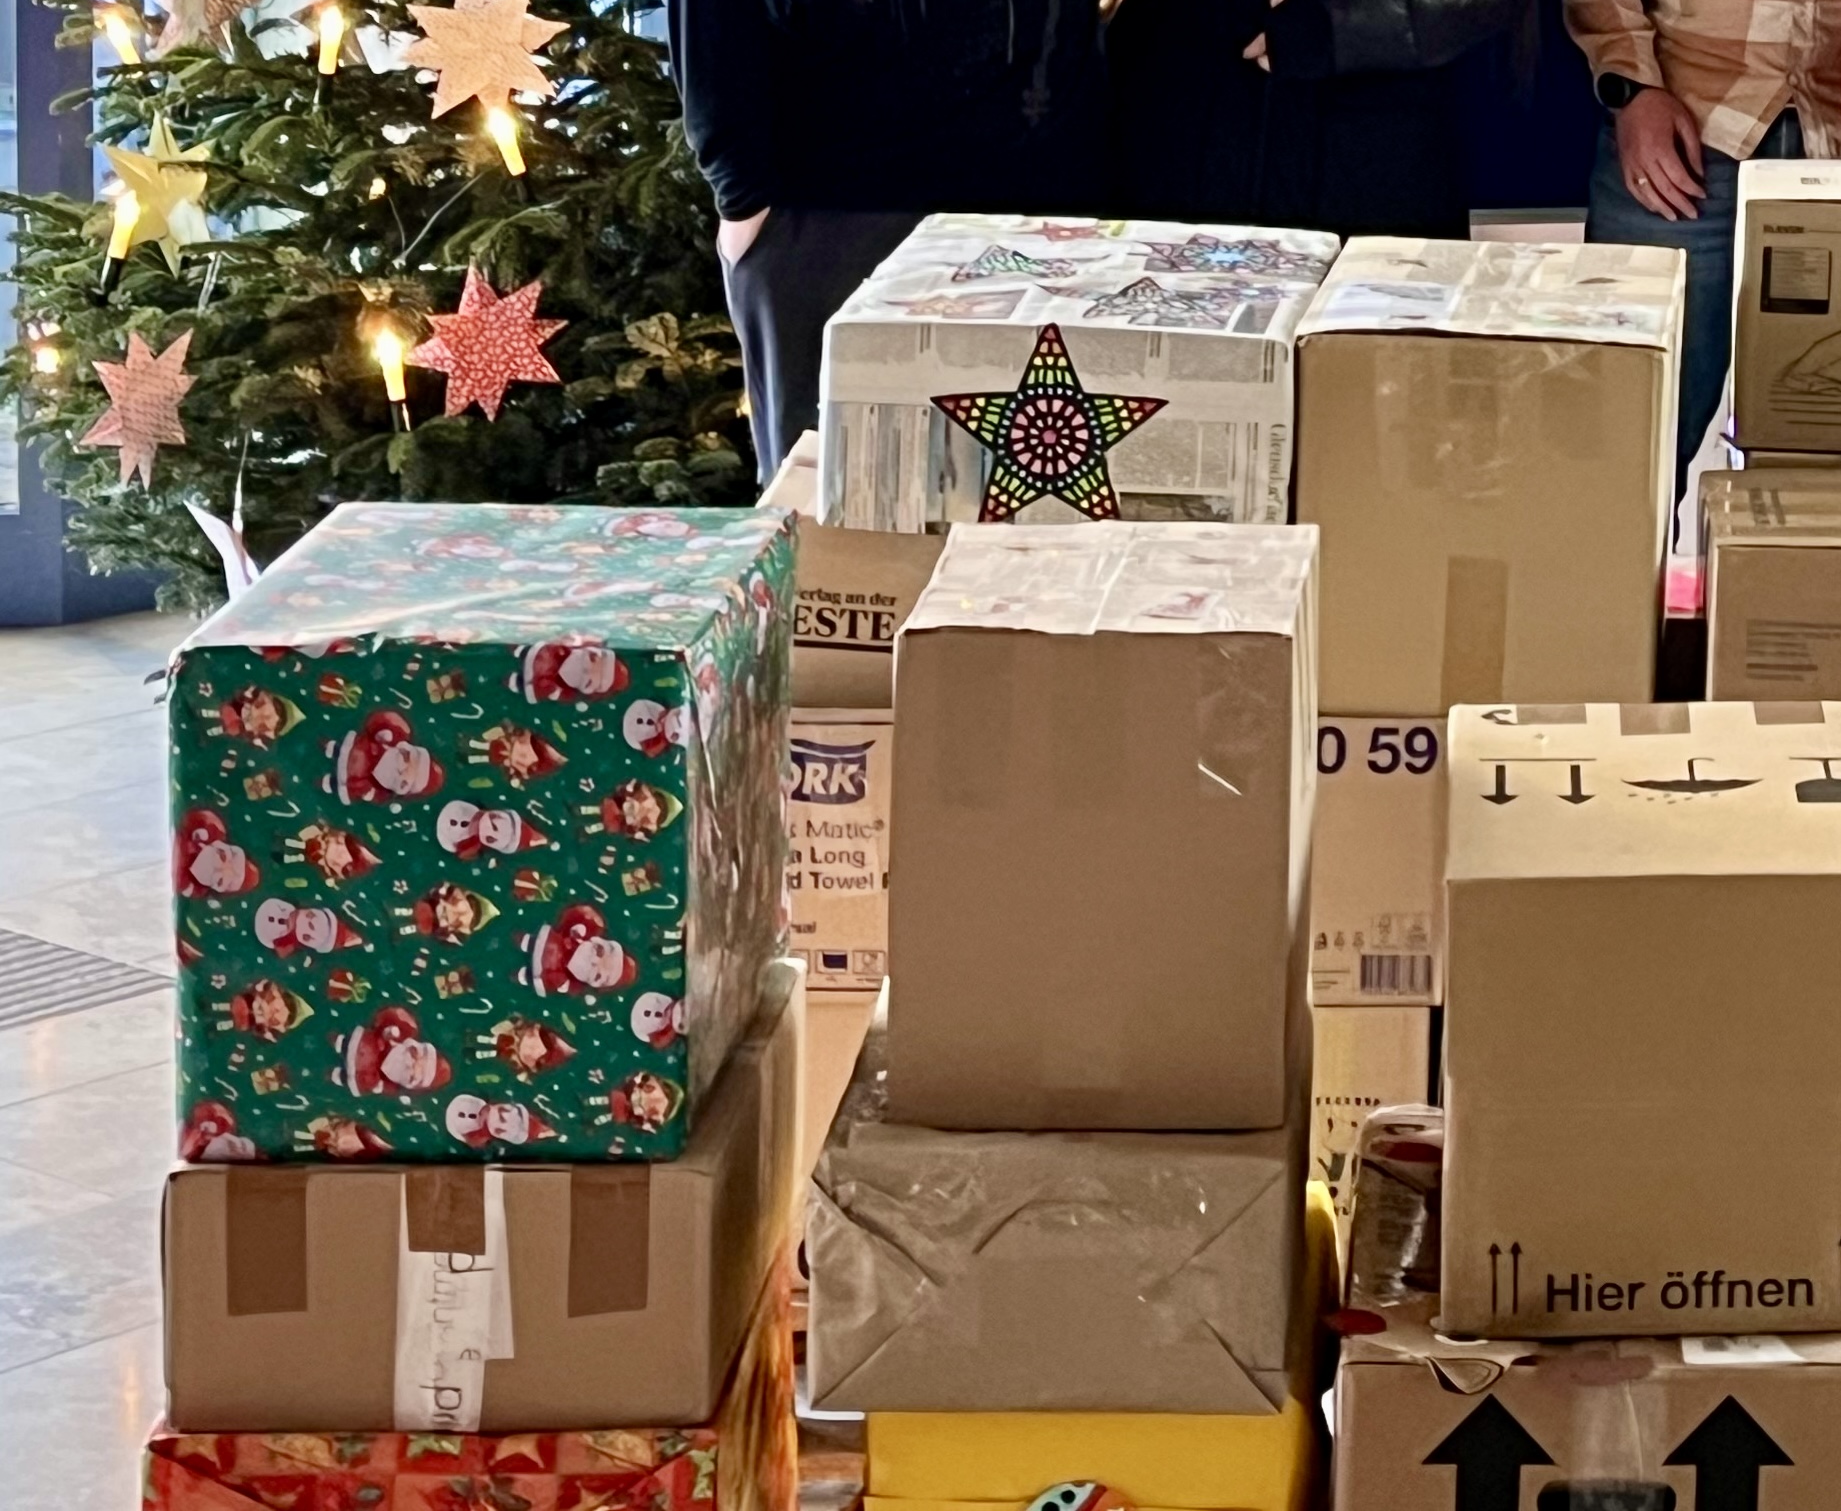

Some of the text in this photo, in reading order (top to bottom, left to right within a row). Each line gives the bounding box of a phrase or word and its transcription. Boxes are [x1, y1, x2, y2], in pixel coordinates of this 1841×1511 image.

[1367, 726, 1439, 775] 59
[810, 846, 865, 869] Long
[808, 871, 875, 890] Towel
[1546, 1269, 1815, 1314] Hier öffnen
